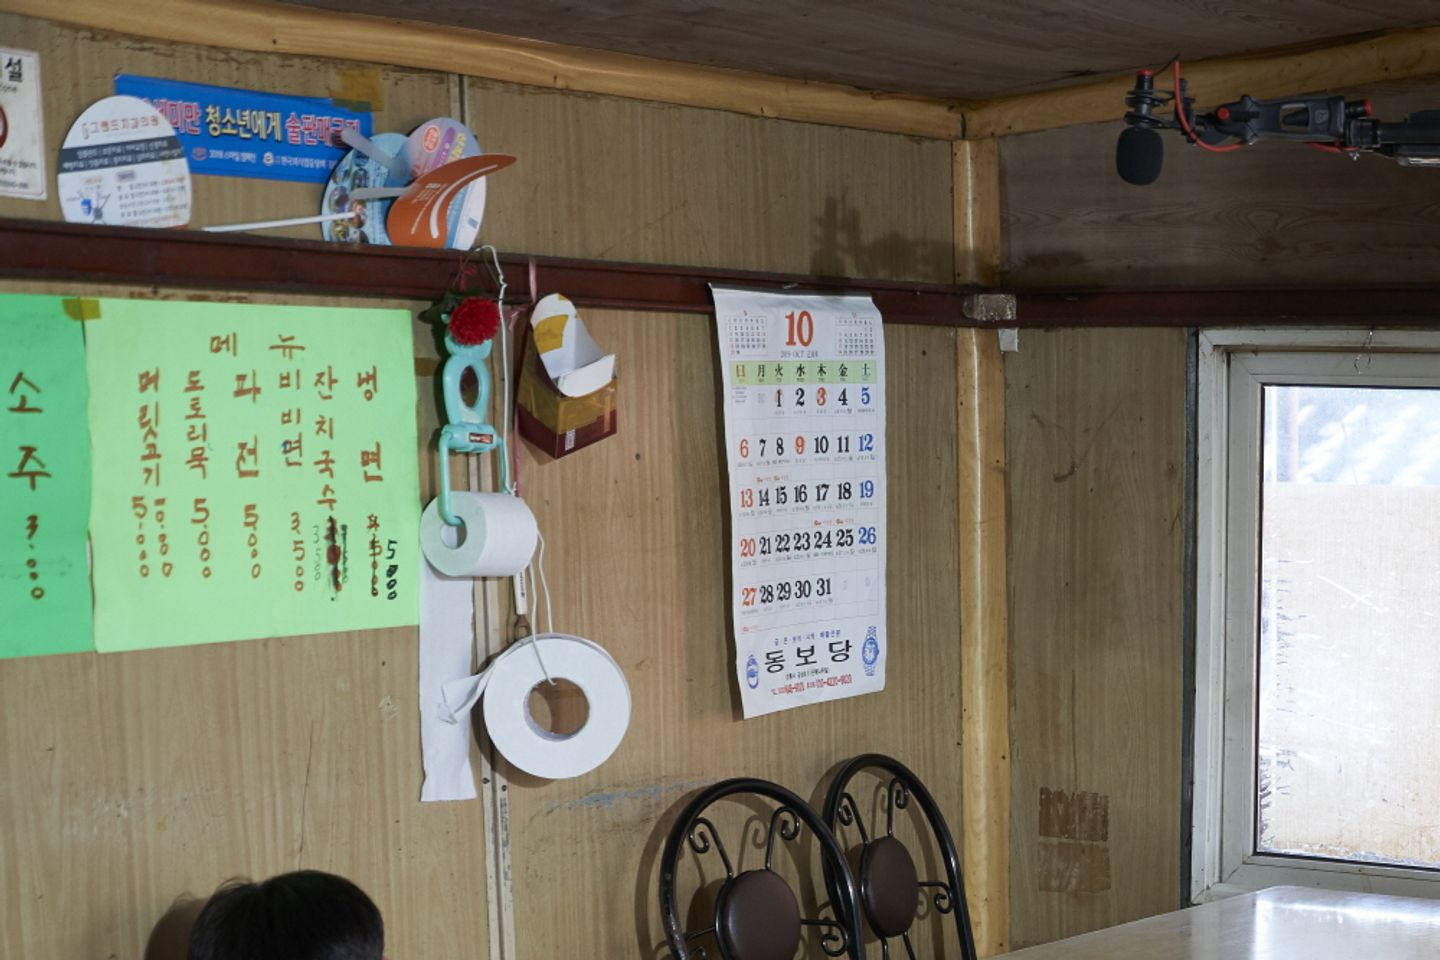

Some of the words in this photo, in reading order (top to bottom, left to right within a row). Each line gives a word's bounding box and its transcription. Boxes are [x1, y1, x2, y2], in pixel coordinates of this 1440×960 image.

[205, 104, 281, 142] 청소년에게
[785, 310, 814, 347] 10
[736, 364, 746, 377] 日
[757, 364, 766, 377] 月
[774, 363, 784, 377] 火
[796, 363, 805, 377] 水
[817, 363, 827, 377] 木
[838, 363, 848, 377] 金
[861, 363, 871, 376] 土
[775, 389, 783, 407] 1
[795, 388, 805, 406] 2
[816, 387, 827, 406] 3
[838, 388, 848, 405] 4
[861, 387, 870, 404] 5
[184, 370, 208, 480] 도토리묵
[313, 365, 338, 511] 잔치국수
[739, 438, 749, 458] 6
[759, 438, 767, 457] 7
[776, 437, 784, 456] 8
[795, 435, 805, 454] 9
[814, 435, 829, 453] 10
[837, 435, 850, 453] 11
[858, 433, 873, 452] 12
[740, 488, 753, 508] 13
[759, 487, 770, 506] 14
[776, 486, 787, 504] 15
[794, 485, 807, 502] 16
[815, 484, 830, 501] 17
[837, 482, 852, 499] 18
[859, 480, 874, 498] 19
[191, 498, 211, 578] 5.000
[740, 538, 756, 557] 20
[759, 536, 771, 555] 21
[775, 534, 790, 552] 22
[794, 532, 811, 551] 23
[814, 530, 832, 549] 24
[836, 529, 854, 547] 25
[858, 527, 876, 545] 26
[742, 588, 757, 606] 27
[760, 585, 774, 604] 28
[777, 582, 791, 600] 29
[795, 580, 811, 598] 30
[816, 578, 831, 596] 31
[764, 640, 852, 674] 동보당
